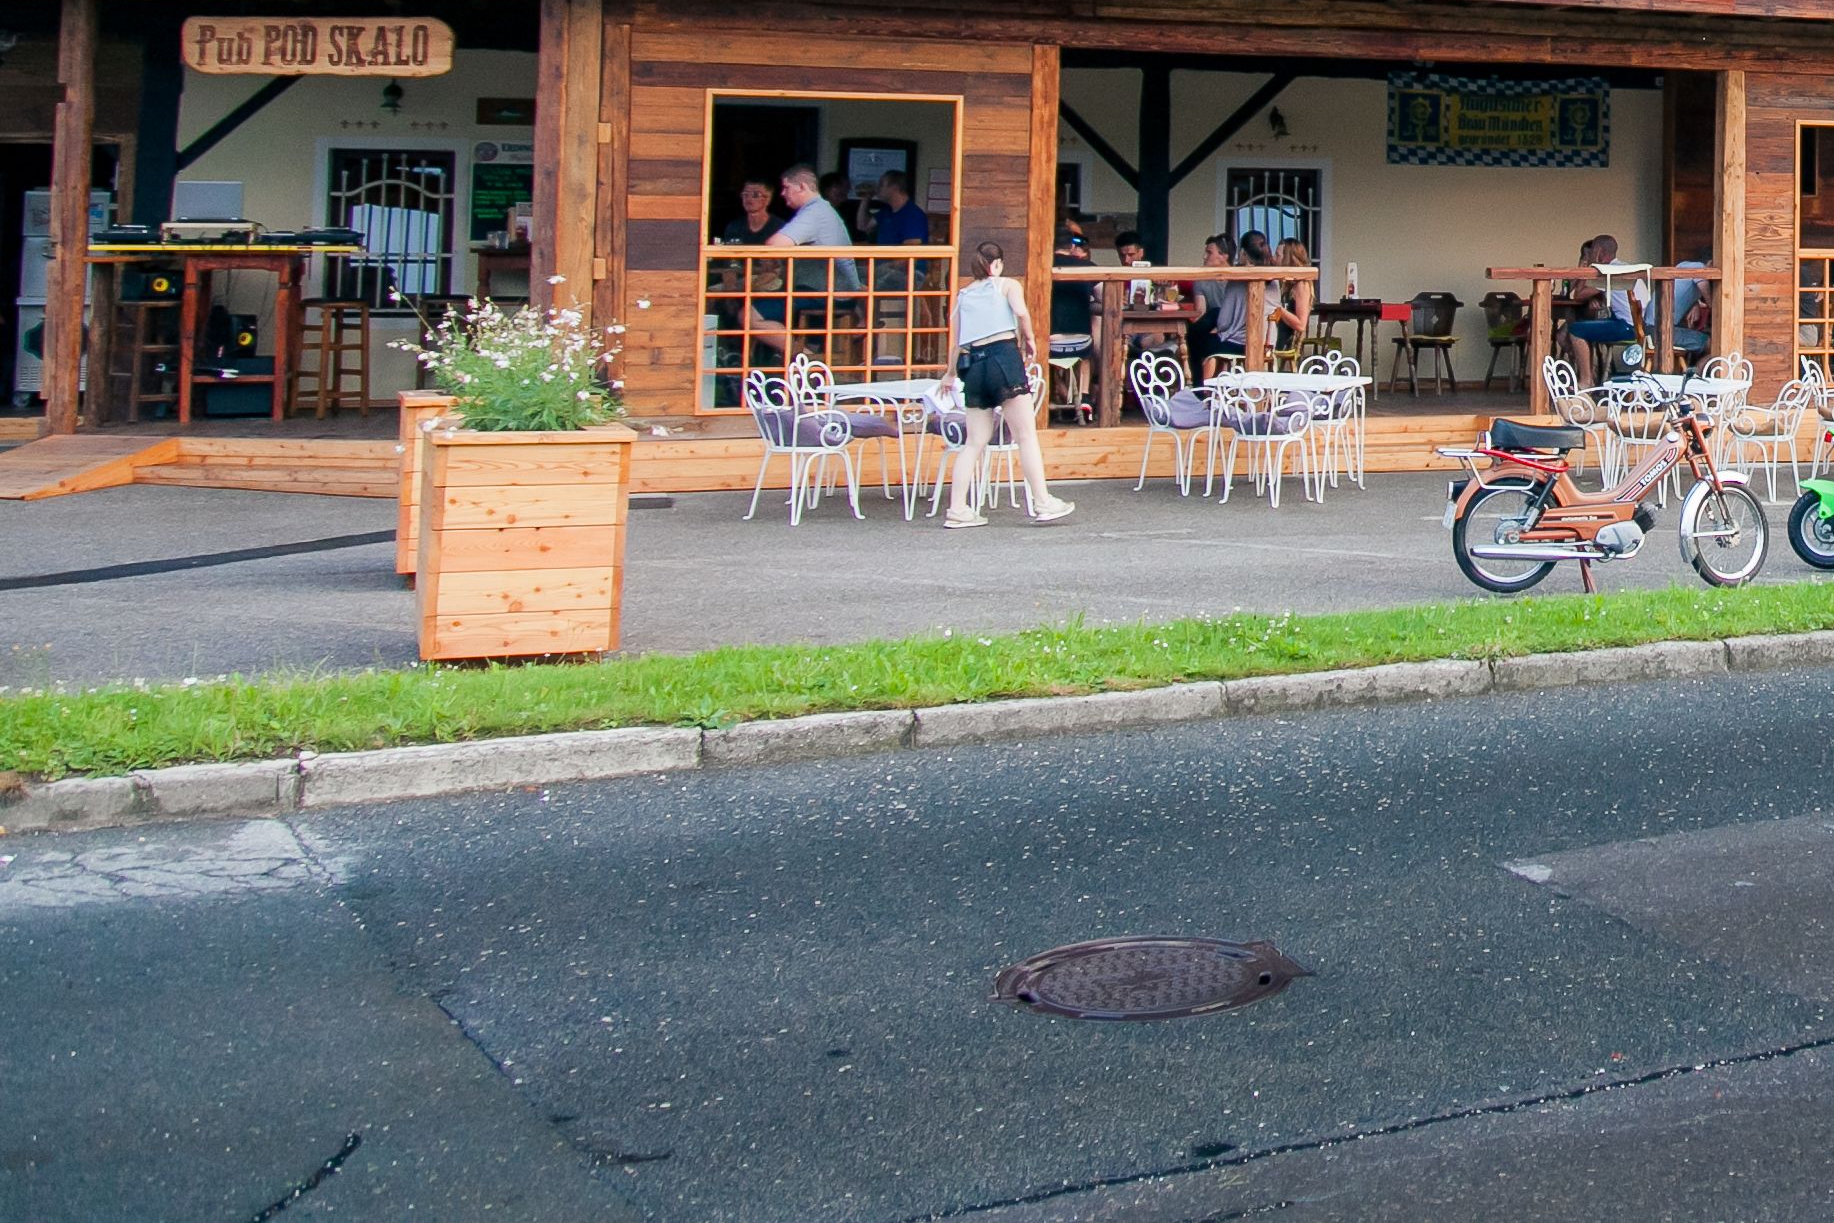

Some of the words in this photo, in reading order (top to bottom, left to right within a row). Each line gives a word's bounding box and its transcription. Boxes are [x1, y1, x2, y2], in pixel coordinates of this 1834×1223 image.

[195, 24, 253, 66] Pub
[260, 24, 319, 67] POD
[327, 24, 430, 68] SKALO
[1639, 458, 1669, 487] TOMOS
